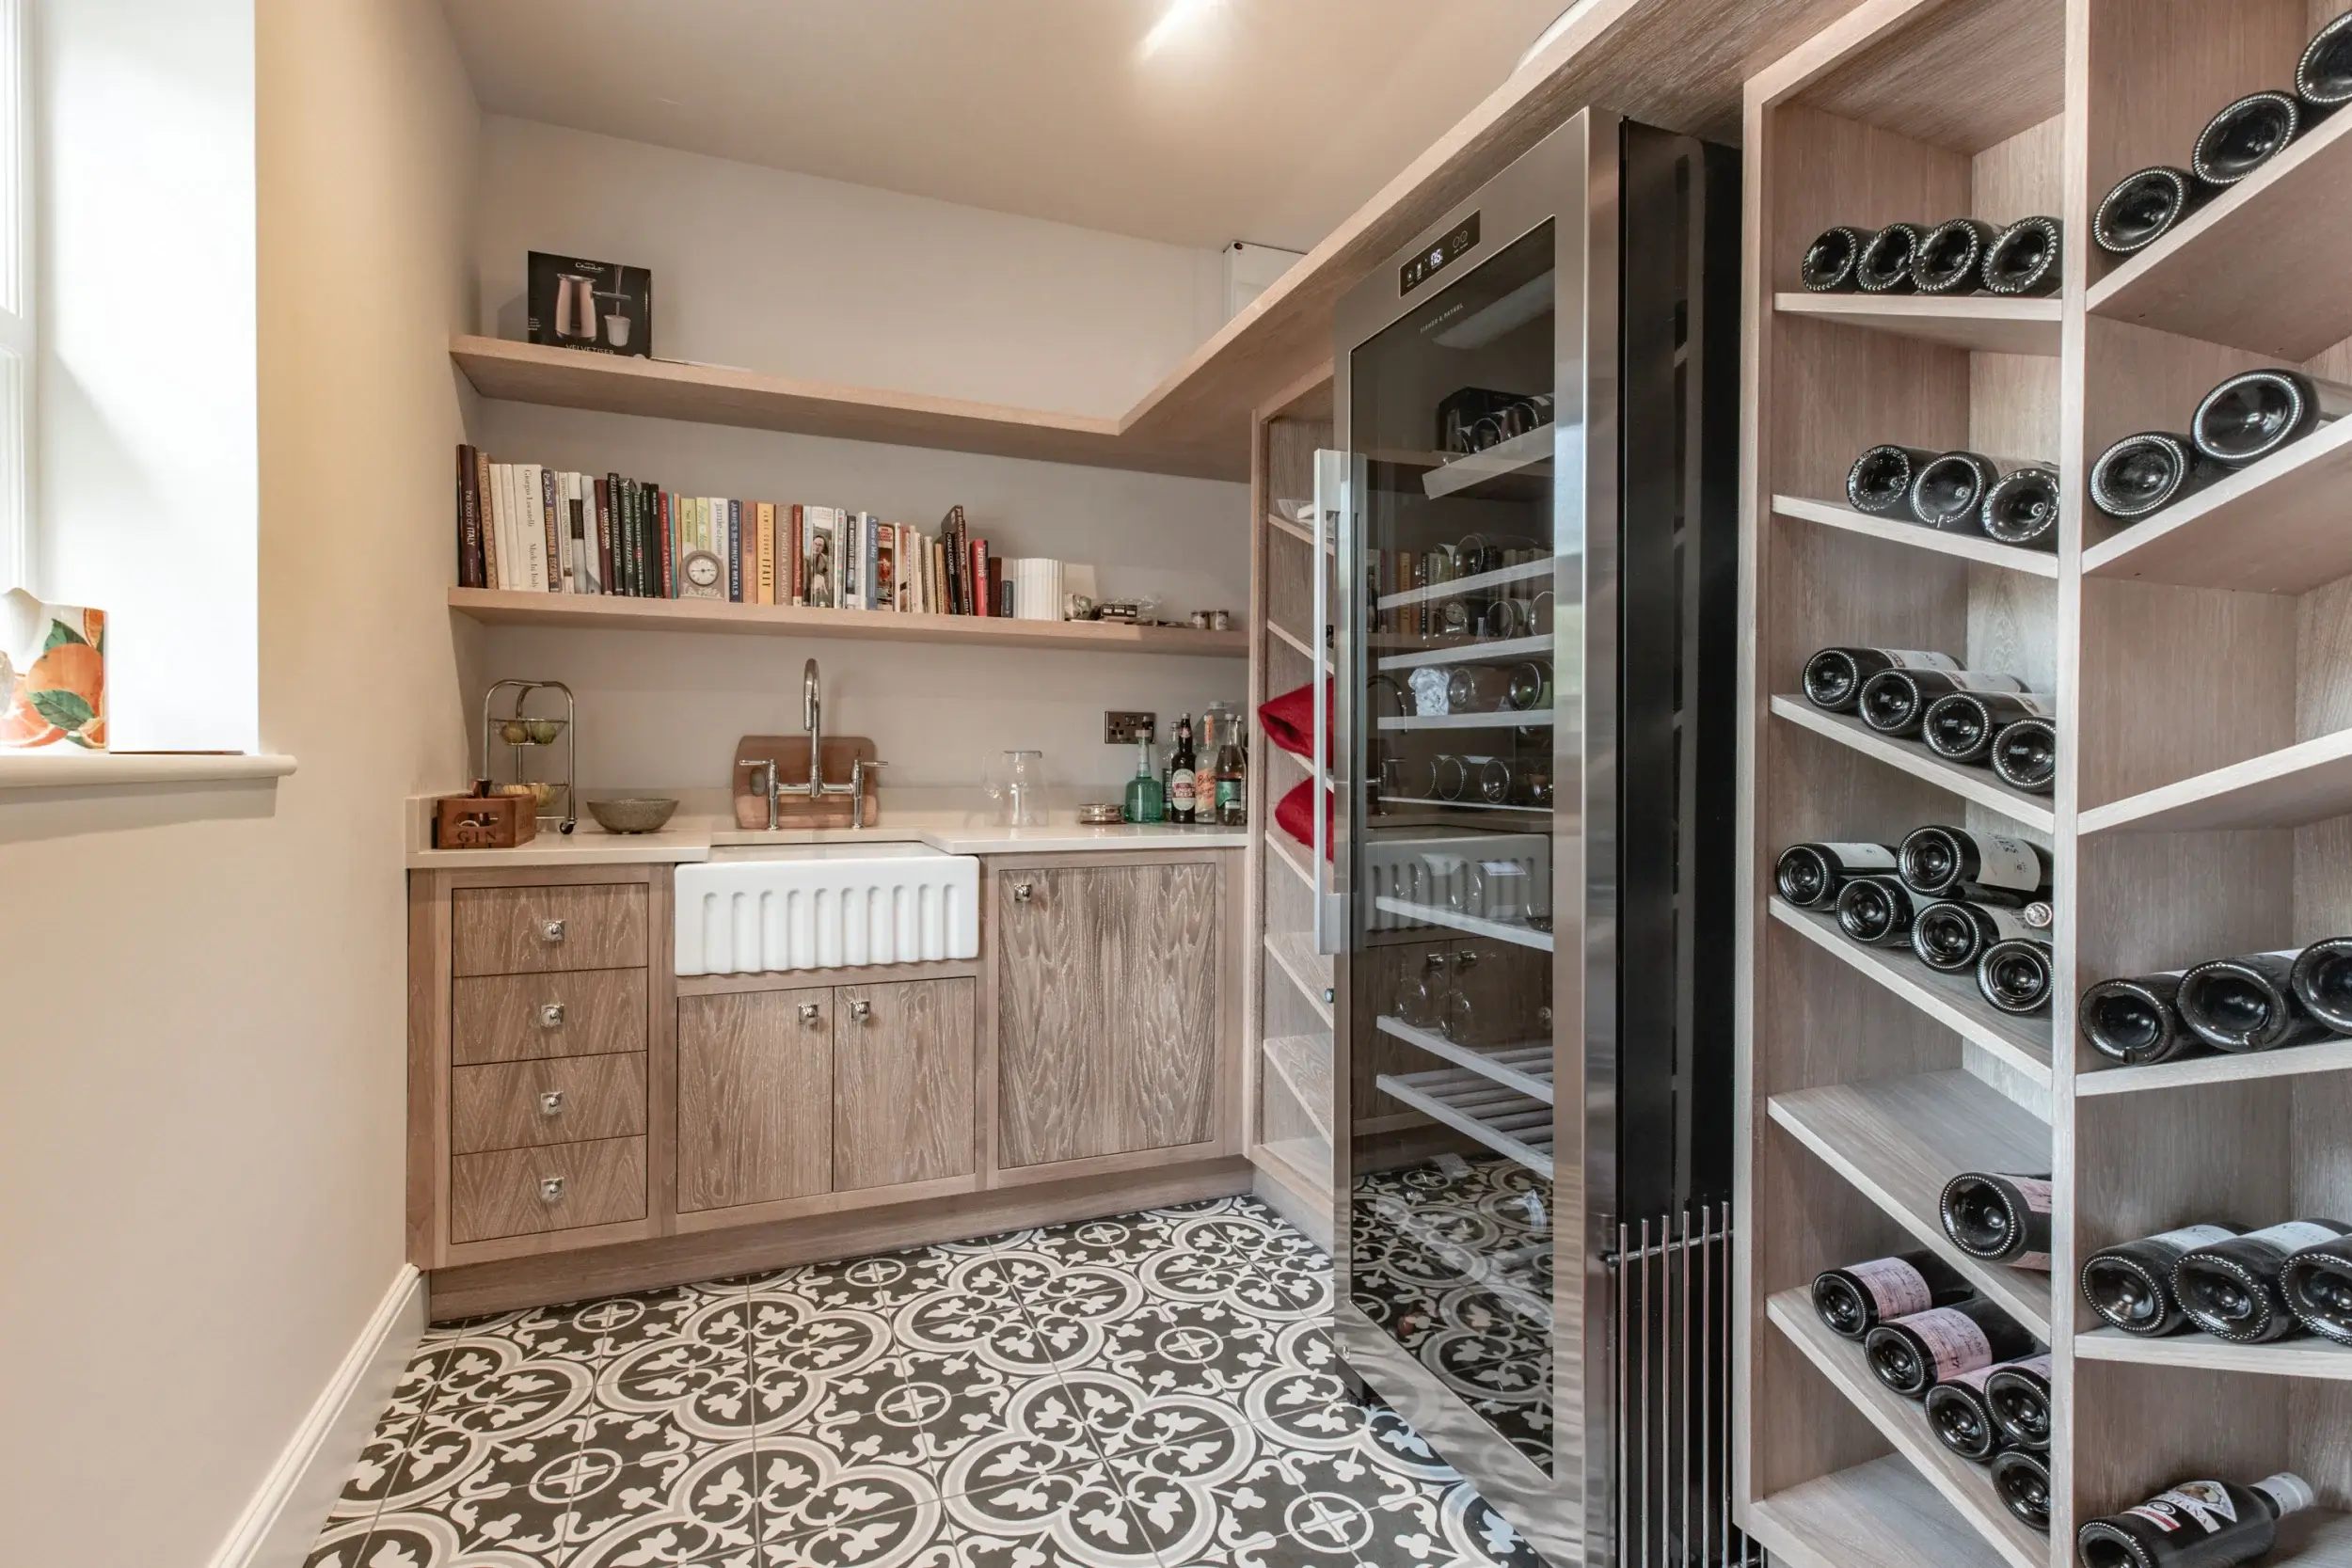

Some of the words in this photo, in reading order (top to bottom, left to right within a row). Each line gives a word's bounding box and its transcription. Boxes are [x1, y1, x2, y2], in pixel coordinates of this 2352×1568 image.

[467, 527, 475, 546] ITALY
[546, 506, 556, 555] MEDITERRANEAN
[549, 557, 558, 583] ESCAPES
[762, 559, 771, 587] ITALY
[457, 830, 498, 844] GIN
